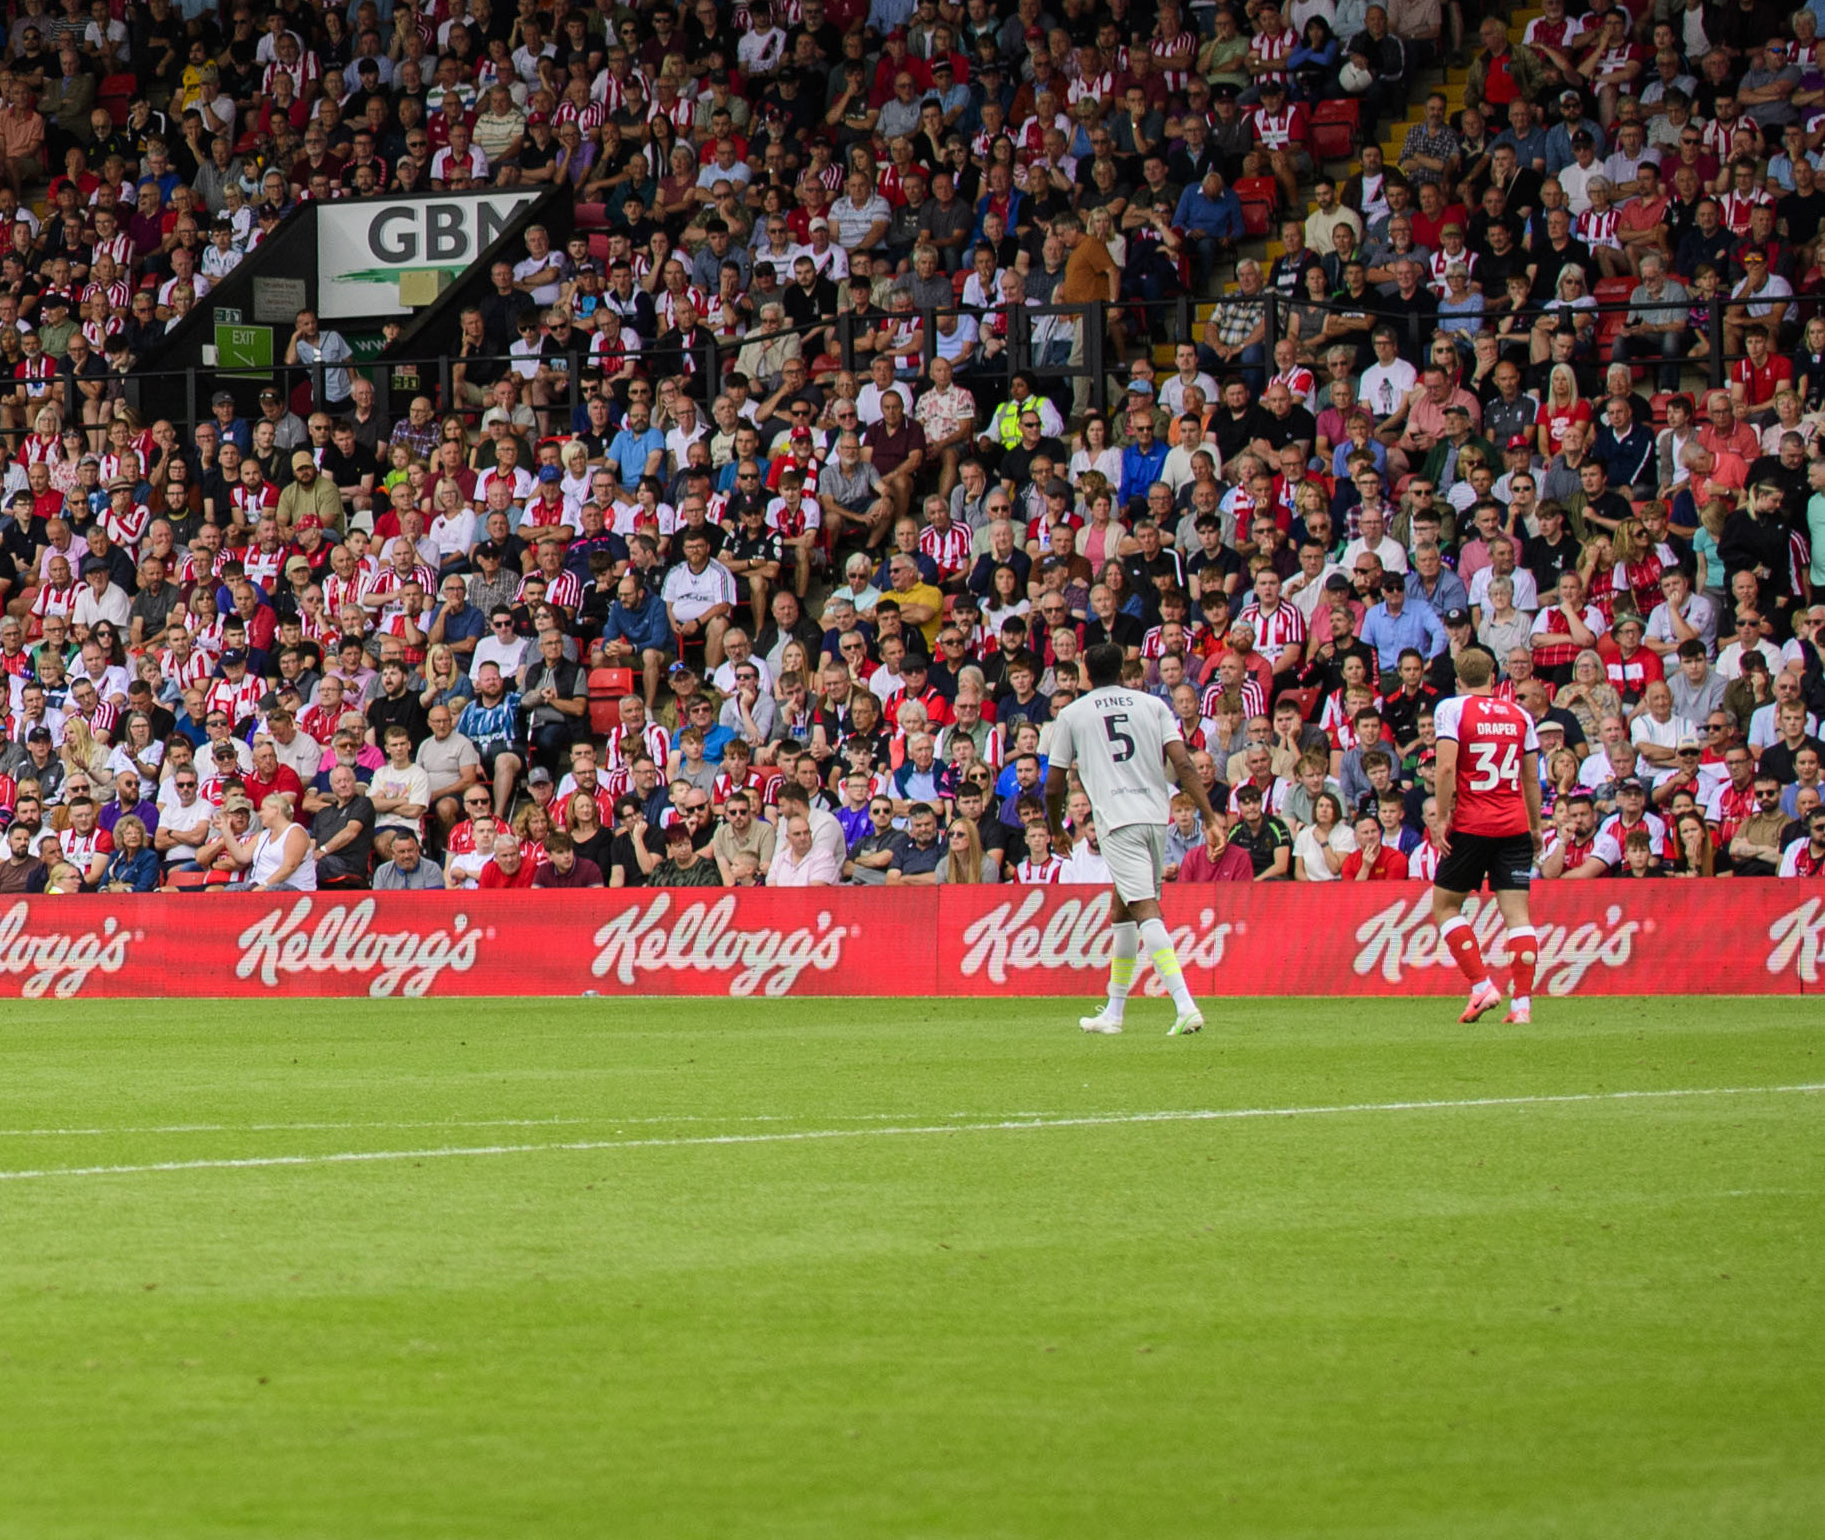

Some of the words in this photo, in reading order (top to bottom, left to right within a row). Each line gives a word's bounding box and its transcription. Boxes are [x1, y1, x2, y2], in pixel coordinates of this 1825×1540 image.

[233, 330, 256, 346] EXIT
[1094, 696, 1134, 709] PINES
[1103, 713, 1136, 763] 5
[1477, 721, 1518, 736] DRAPER
[1469, 742, 1520, 792] 34
[235, 896, 483, 997] Kellogg's
[591, 892, 847, 997] Kellogg's
[960, 889, 1231, 997] Kell's
[1353, 897, 1640, 996] Kelgg's
